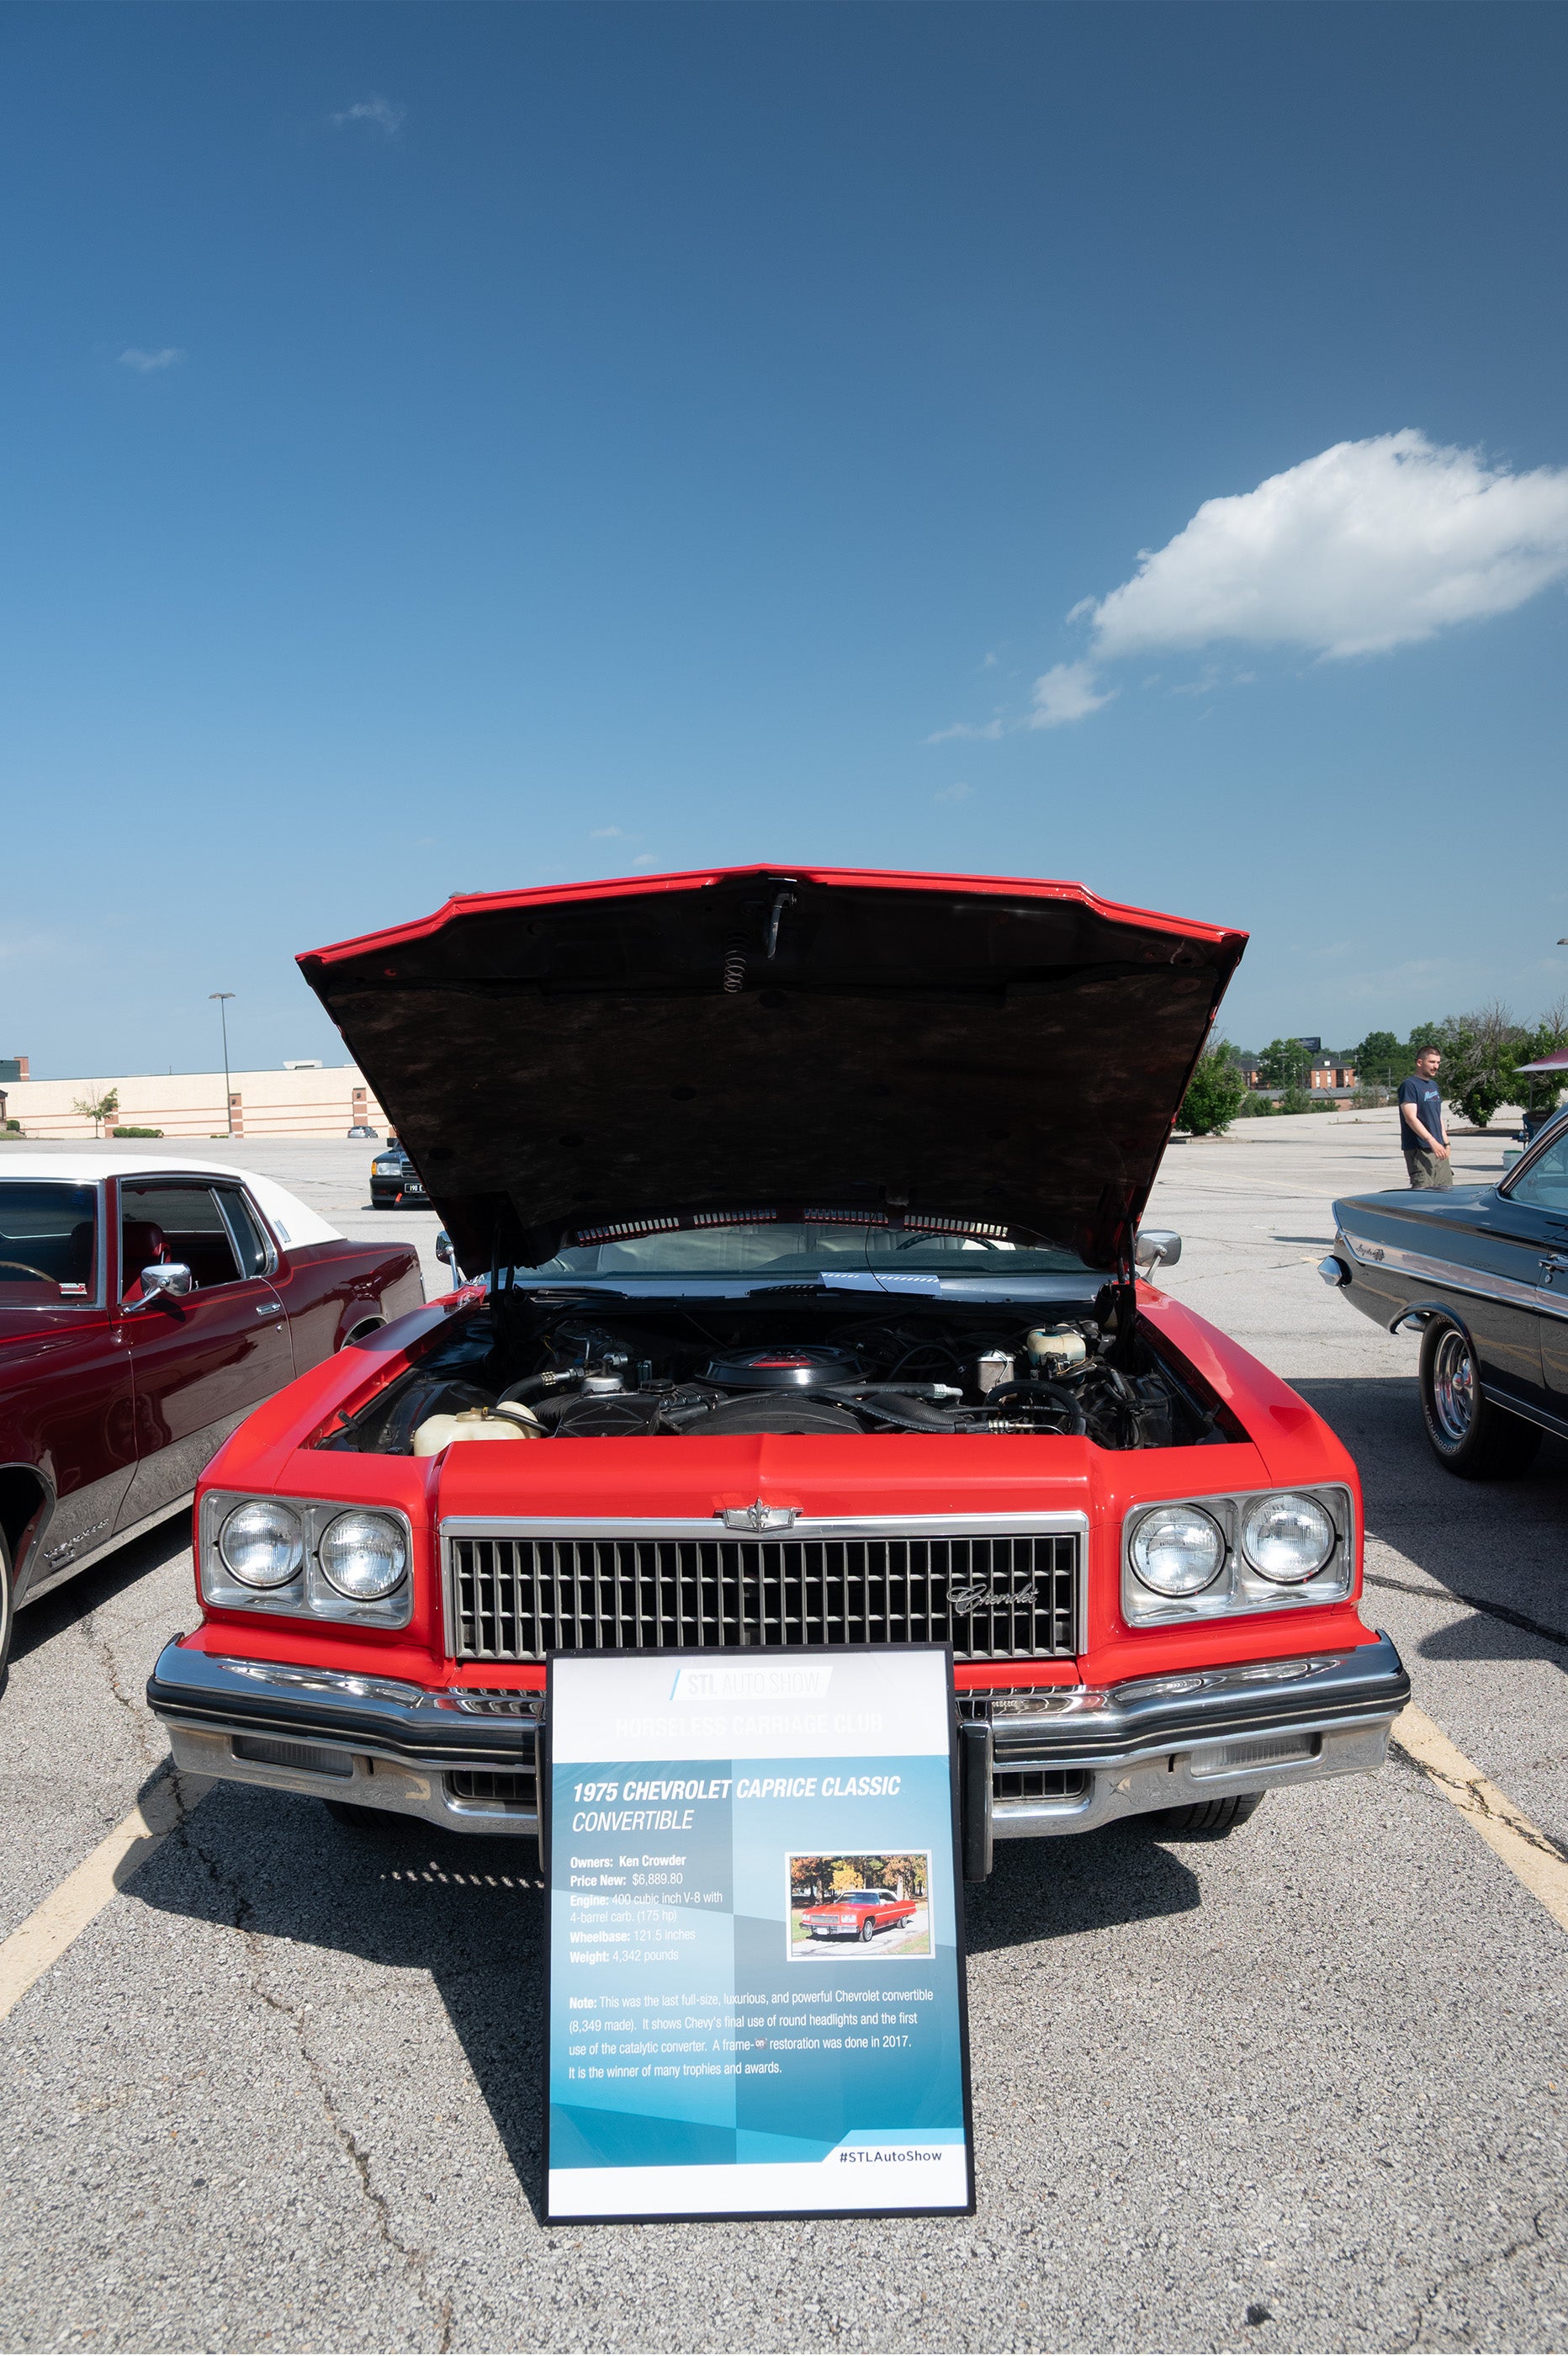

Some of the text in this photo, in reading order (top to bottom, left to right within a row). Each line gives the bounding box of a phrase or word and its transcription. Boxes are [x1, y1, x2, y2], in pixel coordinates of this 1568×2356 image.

[688, 1671, 820, 1695] STL AUTO SHOW
[616, 1711, 883, 1739] HORSELESS CARRIAGE CLUB
[573, 1775, 901, 1802] 1975 CHEVROLET CAPRICE CLASSIC
[572, 1809, 695, 1832] CONVERTIBLE
[570, 1855, 686, 1868] Owners: Ken Crowder
[570, 1873, 683, 1886] Price New: $6,889.80
[570, 1892, 723, 1908] Engine: 400 cubic inch V-8 with
[570, 1909, 677, 1924] 4-barrel carb. (175 hp)
[570, 1929, 696, 1943] Wheelbase: 121.5 inches
[569, 1949, 679, 1965] Weight: 4,342 pounds
[569, 1988, 934, 2008] Note: This was the last full-size, luxurious, and powerful Chevrolet convertible
[569, 2012, 918, 2035] (8,349 made). It shows Chevy's final use of round headlights and the first
[569, 2045, 586, 2056] use
[589, 2043, 598, 2055] of
[601, 2042, 616, 2054] the
[619, 2041, 658, 2056] catalytic
[660, 2040, 707, 2053] converter.
[712, 2040, 720, 2051] A
[770, 2036, 820, 2050] restoration
[823, 2038, 842, 2049] was
[845, 2035, 868, 2048] done
[871, 2035, 880, 2047] in
[882, 2035, 912, 2048] 2017.
[569, 2062, 782, 2078] It is the winner of many trophies and awards.
[840, 2150, 942, 2162] #STLAutoShow
